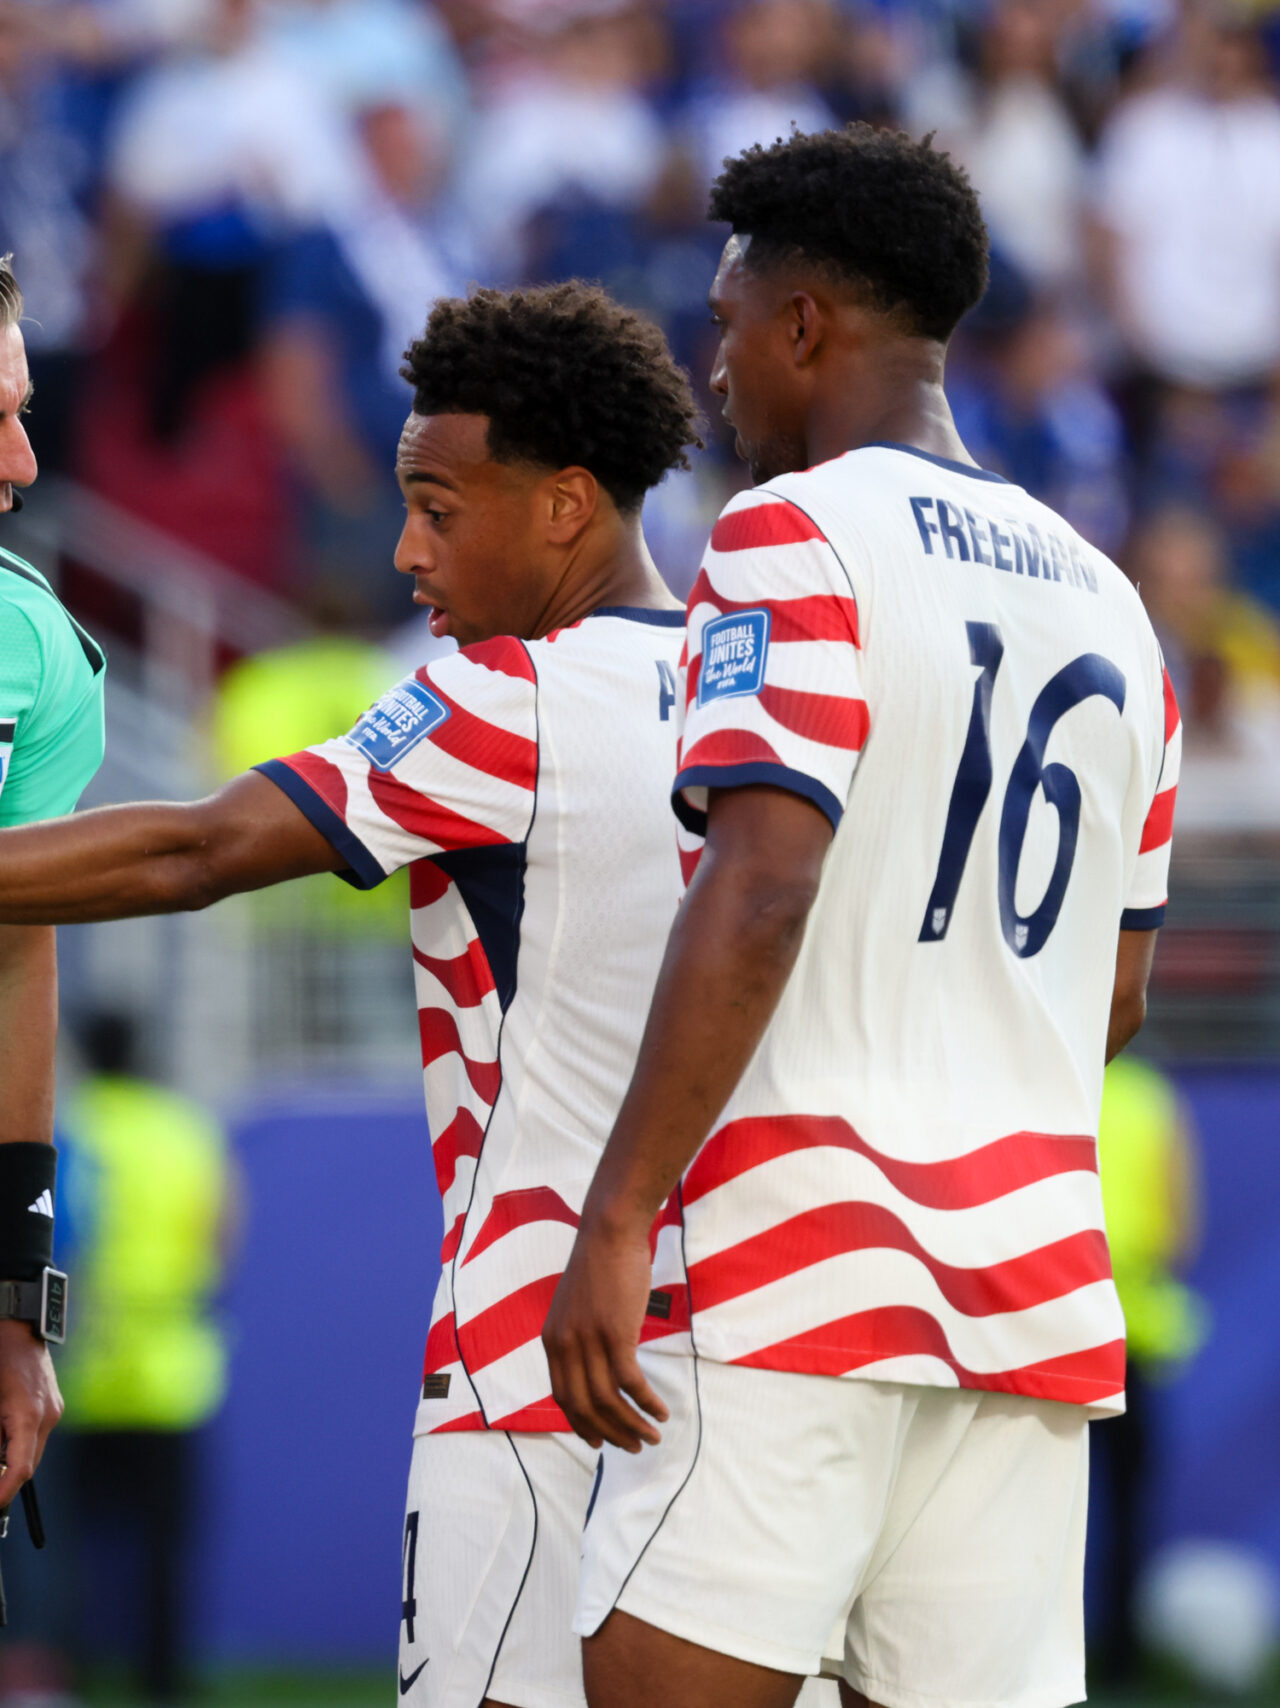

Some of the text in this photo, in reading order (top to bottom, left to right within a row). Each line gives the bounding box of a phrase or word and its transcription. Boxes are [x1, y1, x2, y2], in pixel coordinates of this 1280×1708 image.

[909, 496, 1099, 594] FREEMAN
[710, 624, 756, 648] FOOTBALL
[709, 638, 755, 666] UNITES
[722, 655, 757, 679] World
[917, 620, 1127, 960] 16
